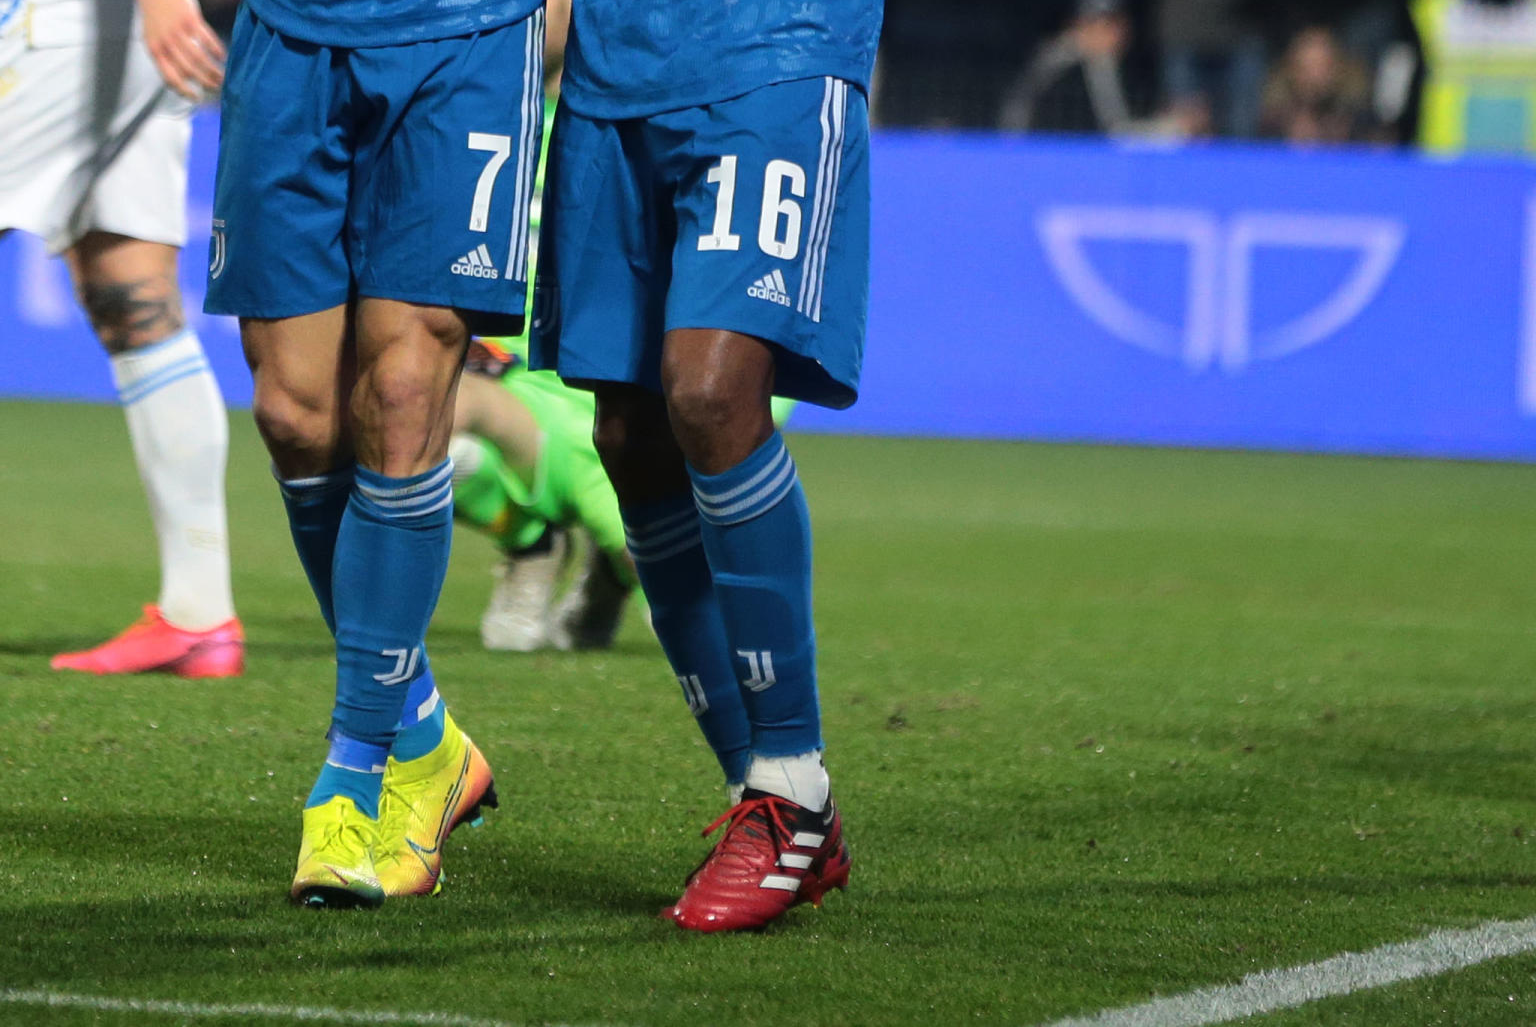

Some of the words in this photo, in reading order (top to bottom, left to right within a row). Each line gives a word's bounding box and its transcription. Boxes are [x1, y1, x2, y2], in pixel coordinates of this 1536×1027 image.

[468, 132, 511, 232] 7
[697, 155, 806, 260] 16
[451, 261, 498, 280] adidas
[747, 285, 792, 308] adidas
